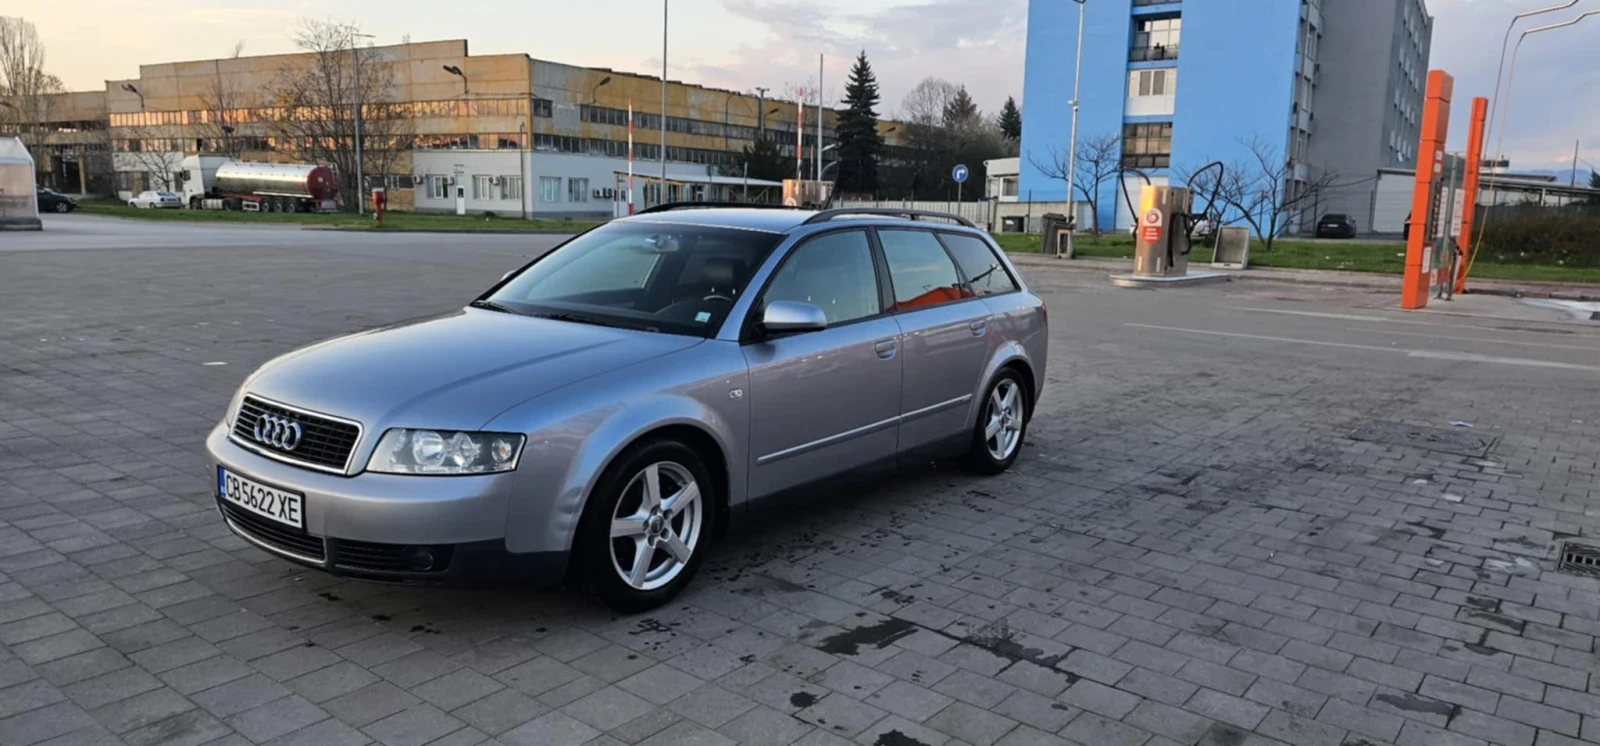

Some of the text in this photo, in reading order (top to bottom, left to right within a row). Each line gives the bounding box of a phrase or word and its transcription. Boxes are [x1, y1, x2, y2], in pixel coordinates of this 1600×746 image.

[226, 474, 241, 502] CB
[242, 481, 276, 516] 5622
[278, 493, 299, 523] XE
